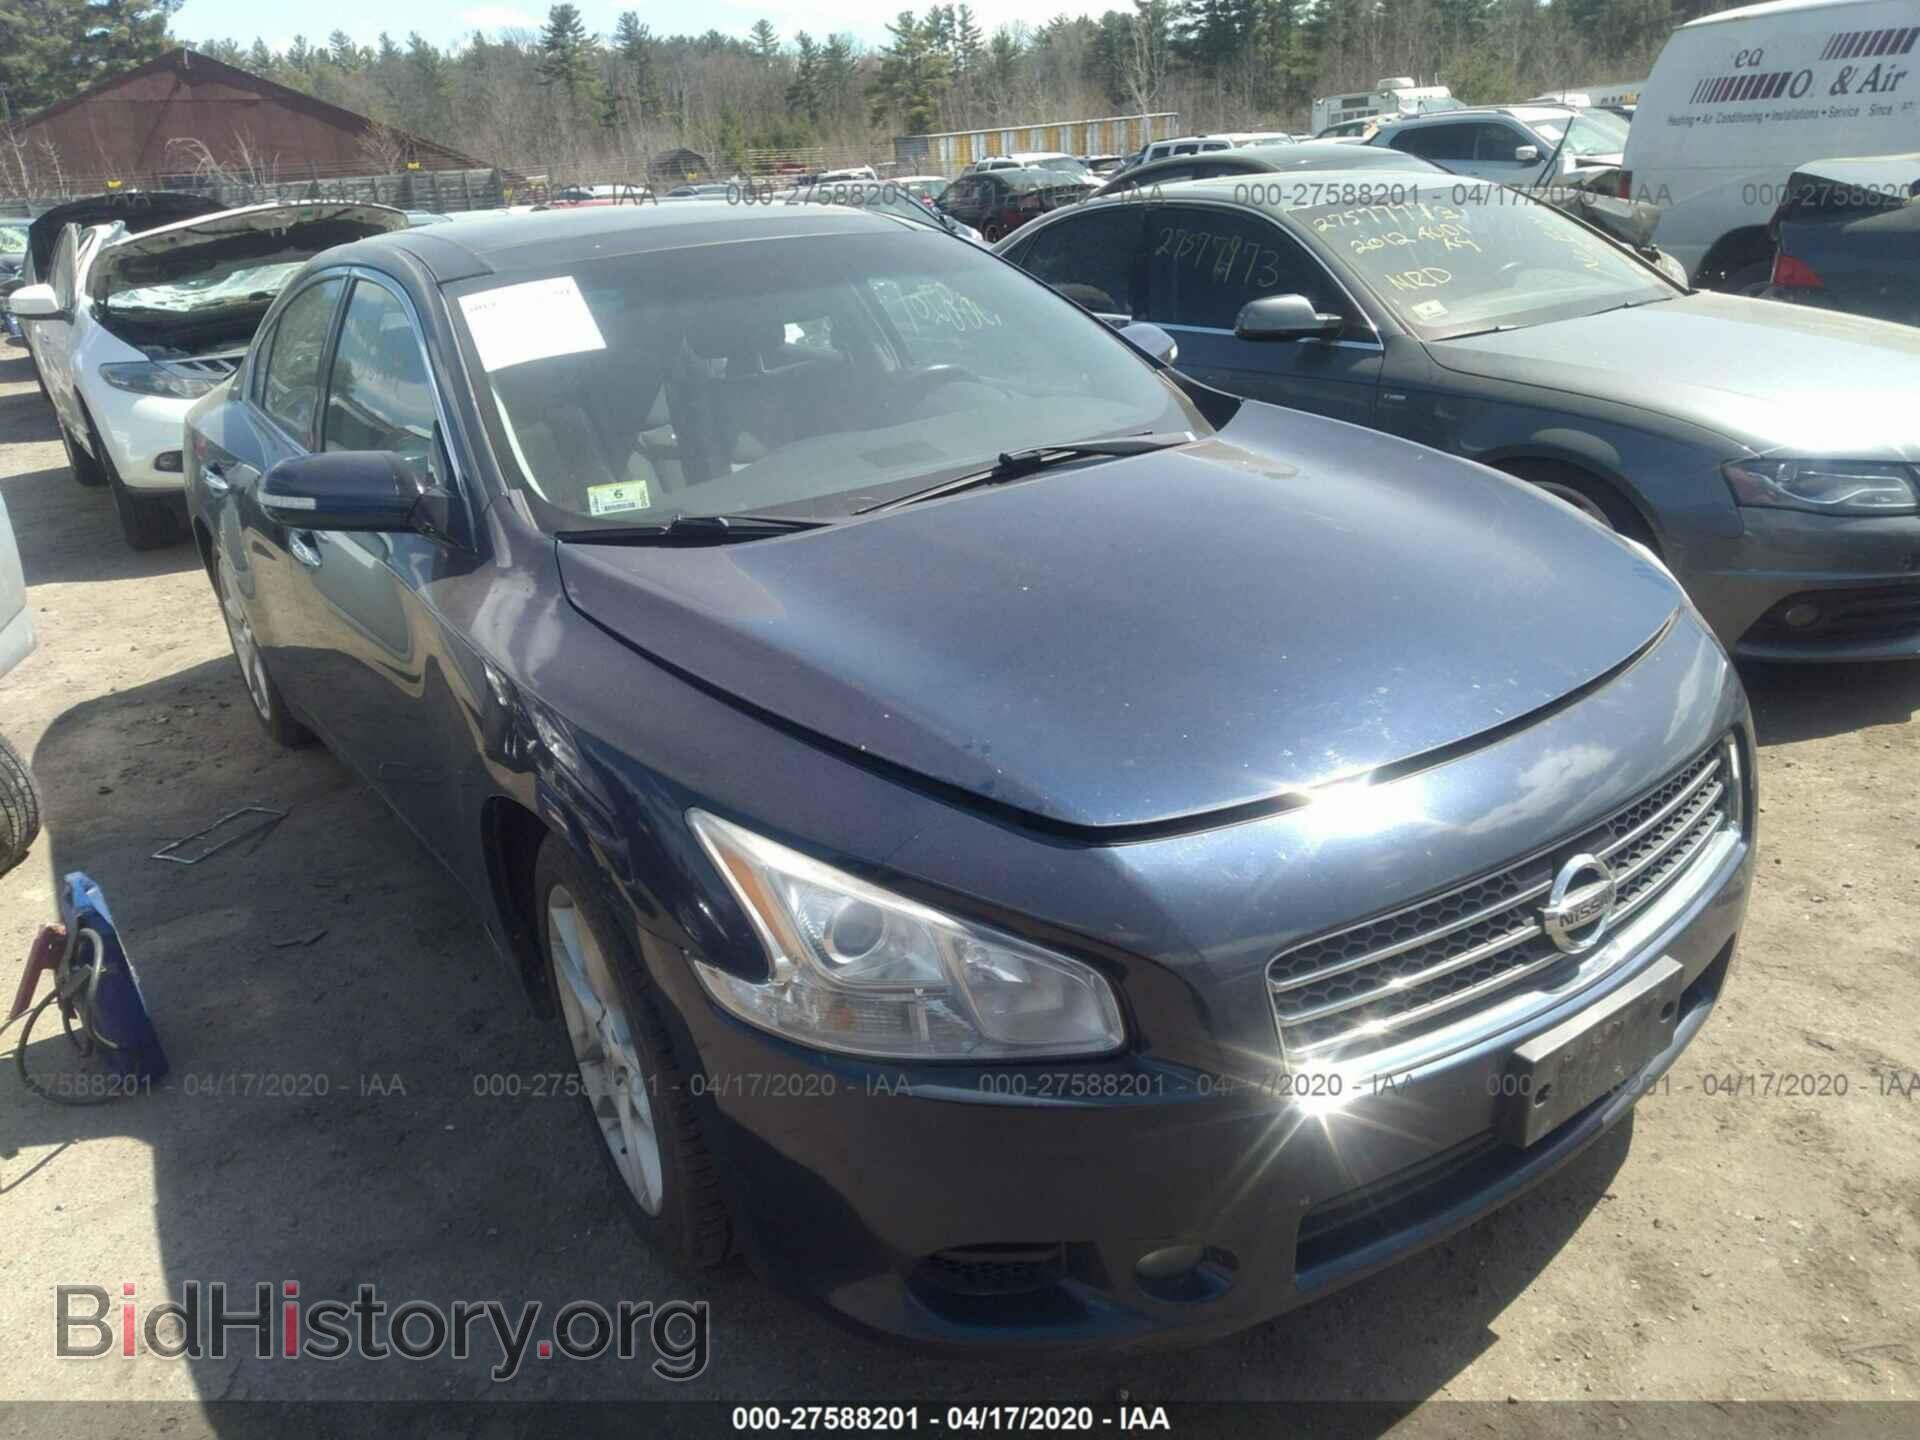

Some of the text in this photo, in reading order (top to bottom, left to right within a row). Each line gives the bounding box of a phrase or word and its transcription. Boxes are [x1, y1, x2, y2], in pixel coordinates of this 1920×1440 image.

[1734, 48, 1764, 68] ea
[1829, 65, 1858, 96] &
[1856, 62, 1908, 94] Air
[1715, 110, 1763, 124] Conditioning
[1771, 108, 1819, 121] Installations
[1828, 105, 1859, 119] Service
[1868, 103, 1893, 116] Since
[1350, 231, 1417, 255] 2012
